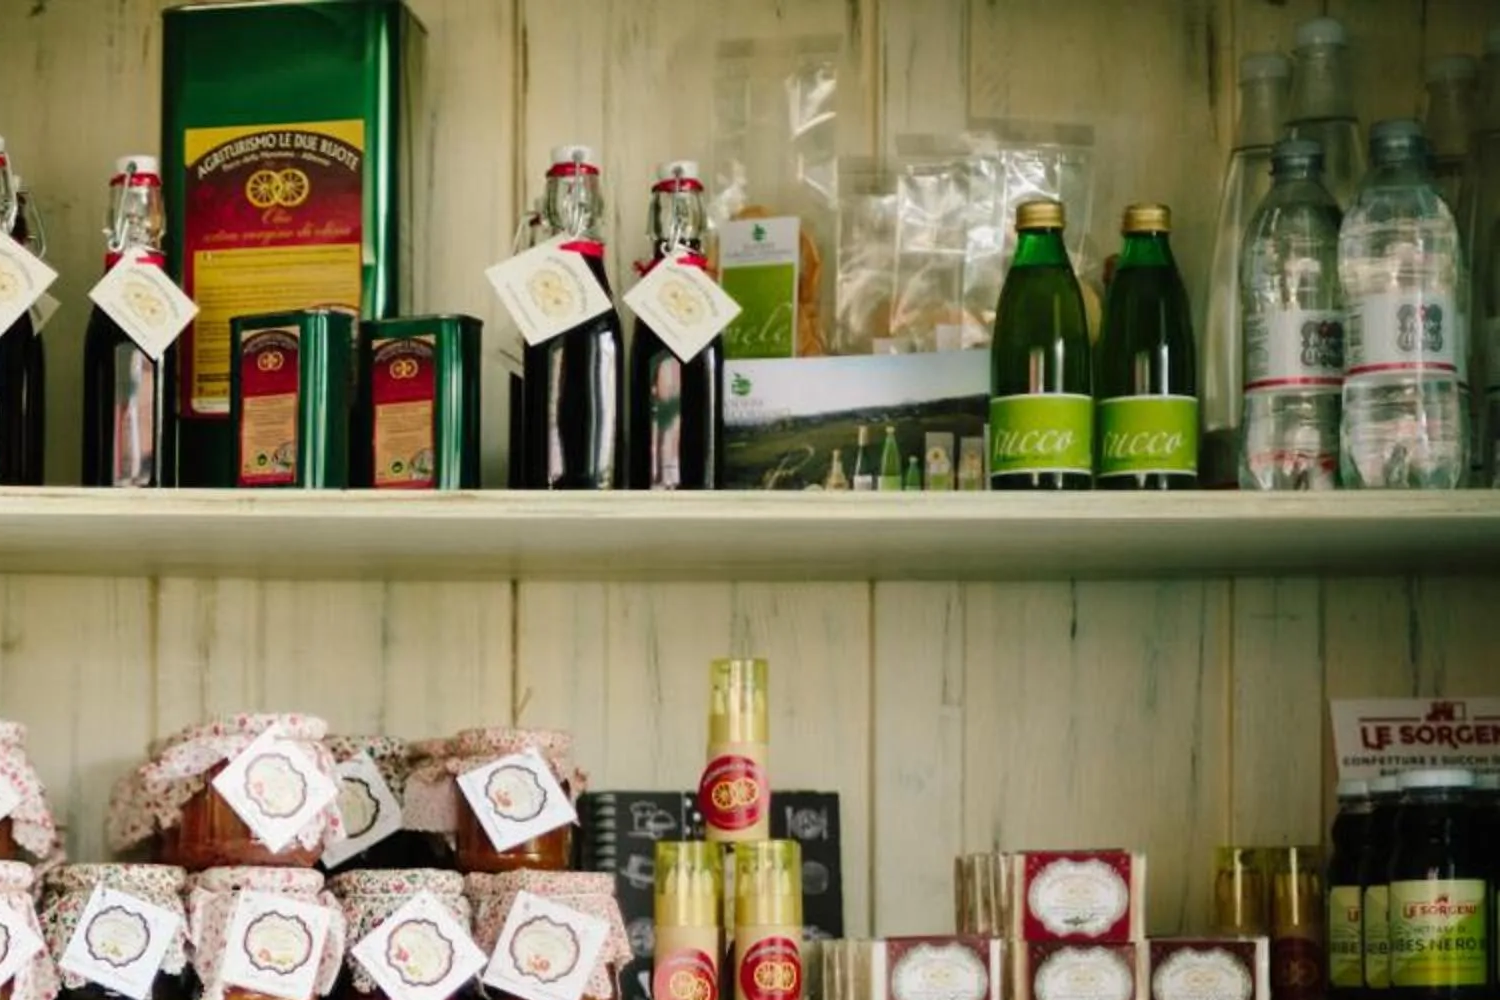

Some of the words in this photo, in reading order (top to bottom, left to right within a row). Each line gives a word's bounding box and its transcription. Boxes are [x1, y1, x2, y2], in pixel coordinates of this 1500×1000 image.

[279, 132, 293, 148] LE
[294, 132, 319, 151] DUE
[320, 136, 360, 172] RUOTE
[1360, 725, 1393, 751] LE
